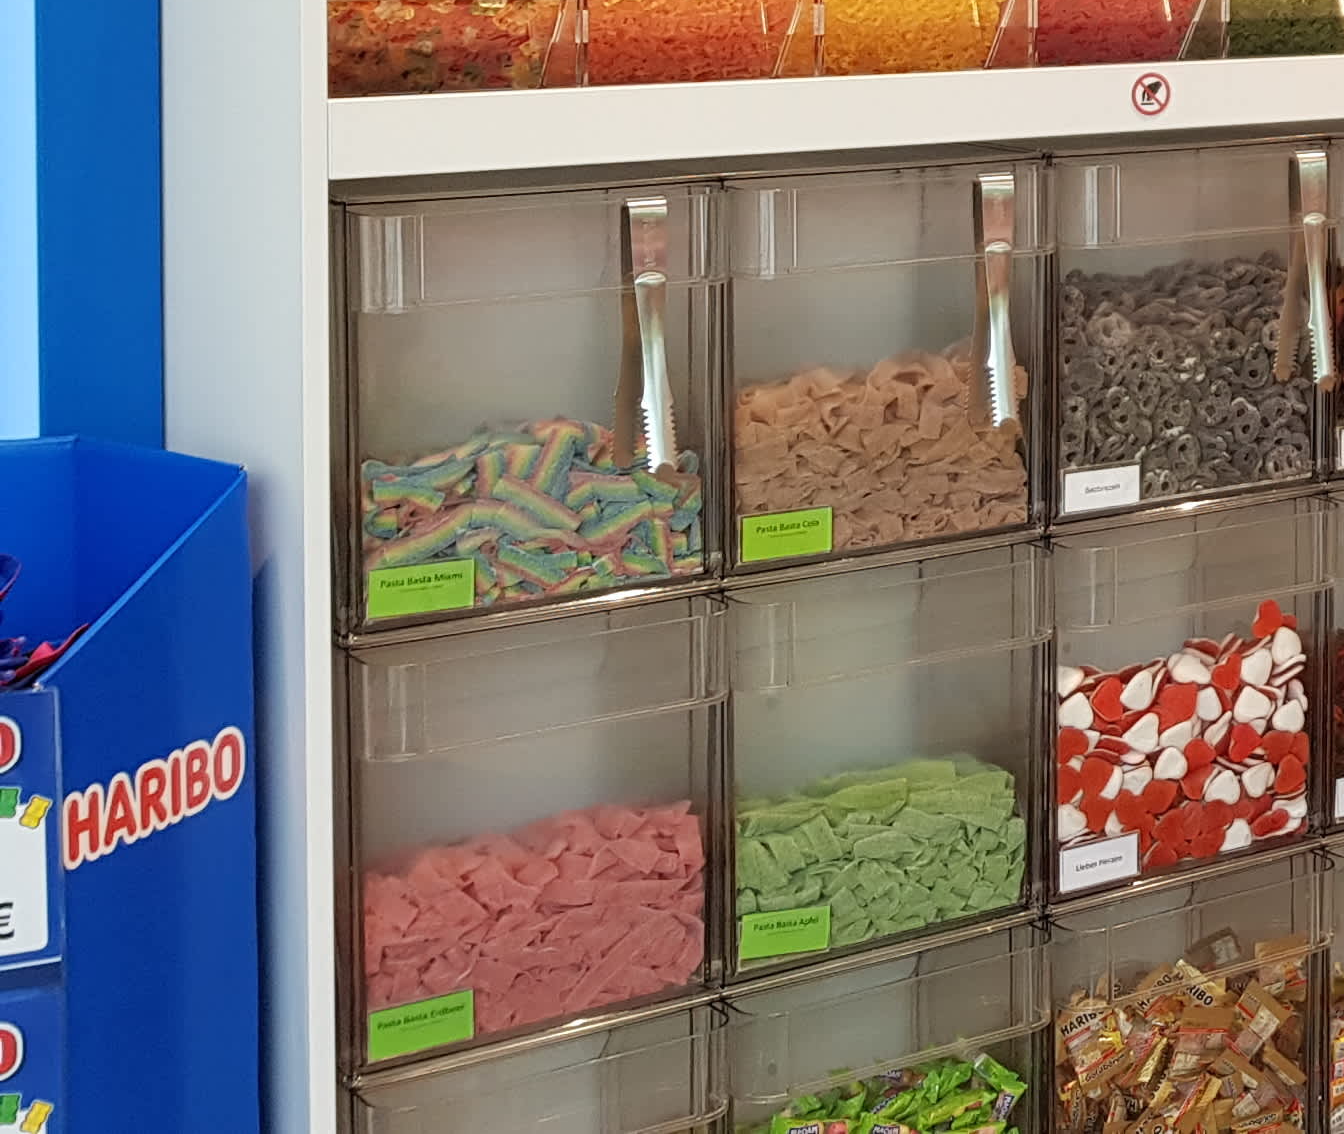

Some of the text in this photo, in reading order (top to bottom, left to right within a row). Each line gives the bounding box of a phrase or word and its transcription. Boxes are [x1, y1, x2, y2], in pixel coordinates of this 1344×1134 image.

[756, 523, 777, 533] Pasta
[779, 520, 801, 531] Basta
[380, 576, 405, 589] Pasta
[407, 574, 432, 587] Basta
[65, 730, 243, 865] HARIBO
